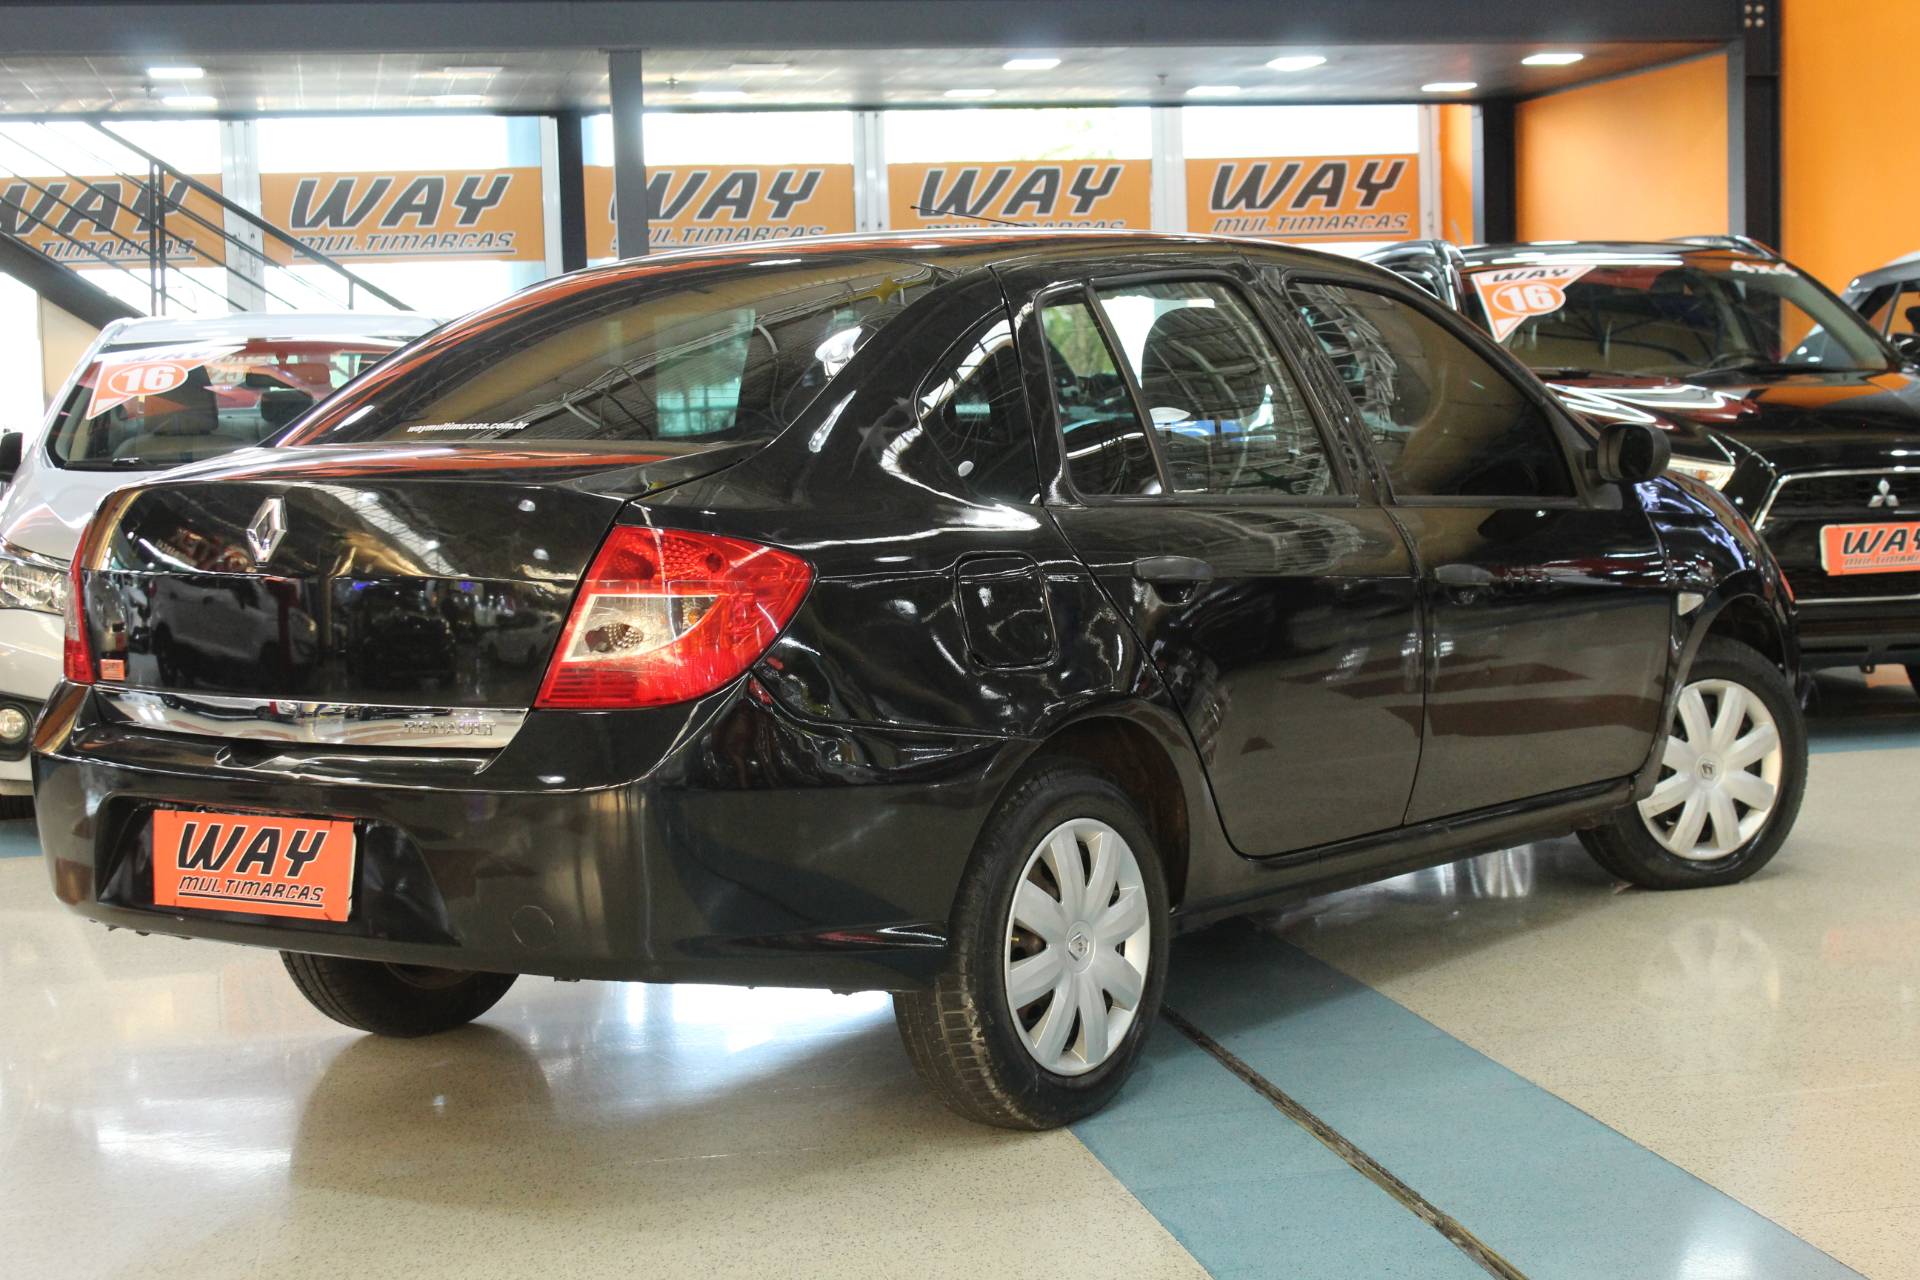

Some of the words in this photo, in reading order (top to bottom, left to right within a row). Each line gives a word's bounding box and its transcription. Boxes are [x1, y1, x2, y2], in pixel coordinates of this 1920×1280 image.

[609, 169, 824, 221] WAY
[918, 165, 1123, 218] WAY
[1210, 160, 1407, 212] WAY
[290, 175, 512, 230] WAY
[647, 225, 826, 244] ULTIMARCAS
[1213, 214, 1409, 232] MULTIMARCAS
[298, 232, 514, 252] MULTIMARCAS
[1501, 285, 1556, 311] 16
[119, 365, 176, 392] 16
[403, 720, 497, 736] RENAULT
[177, 822, 329, 879] WAY
[178, 875, 325, 901] MULTIMARCAS
